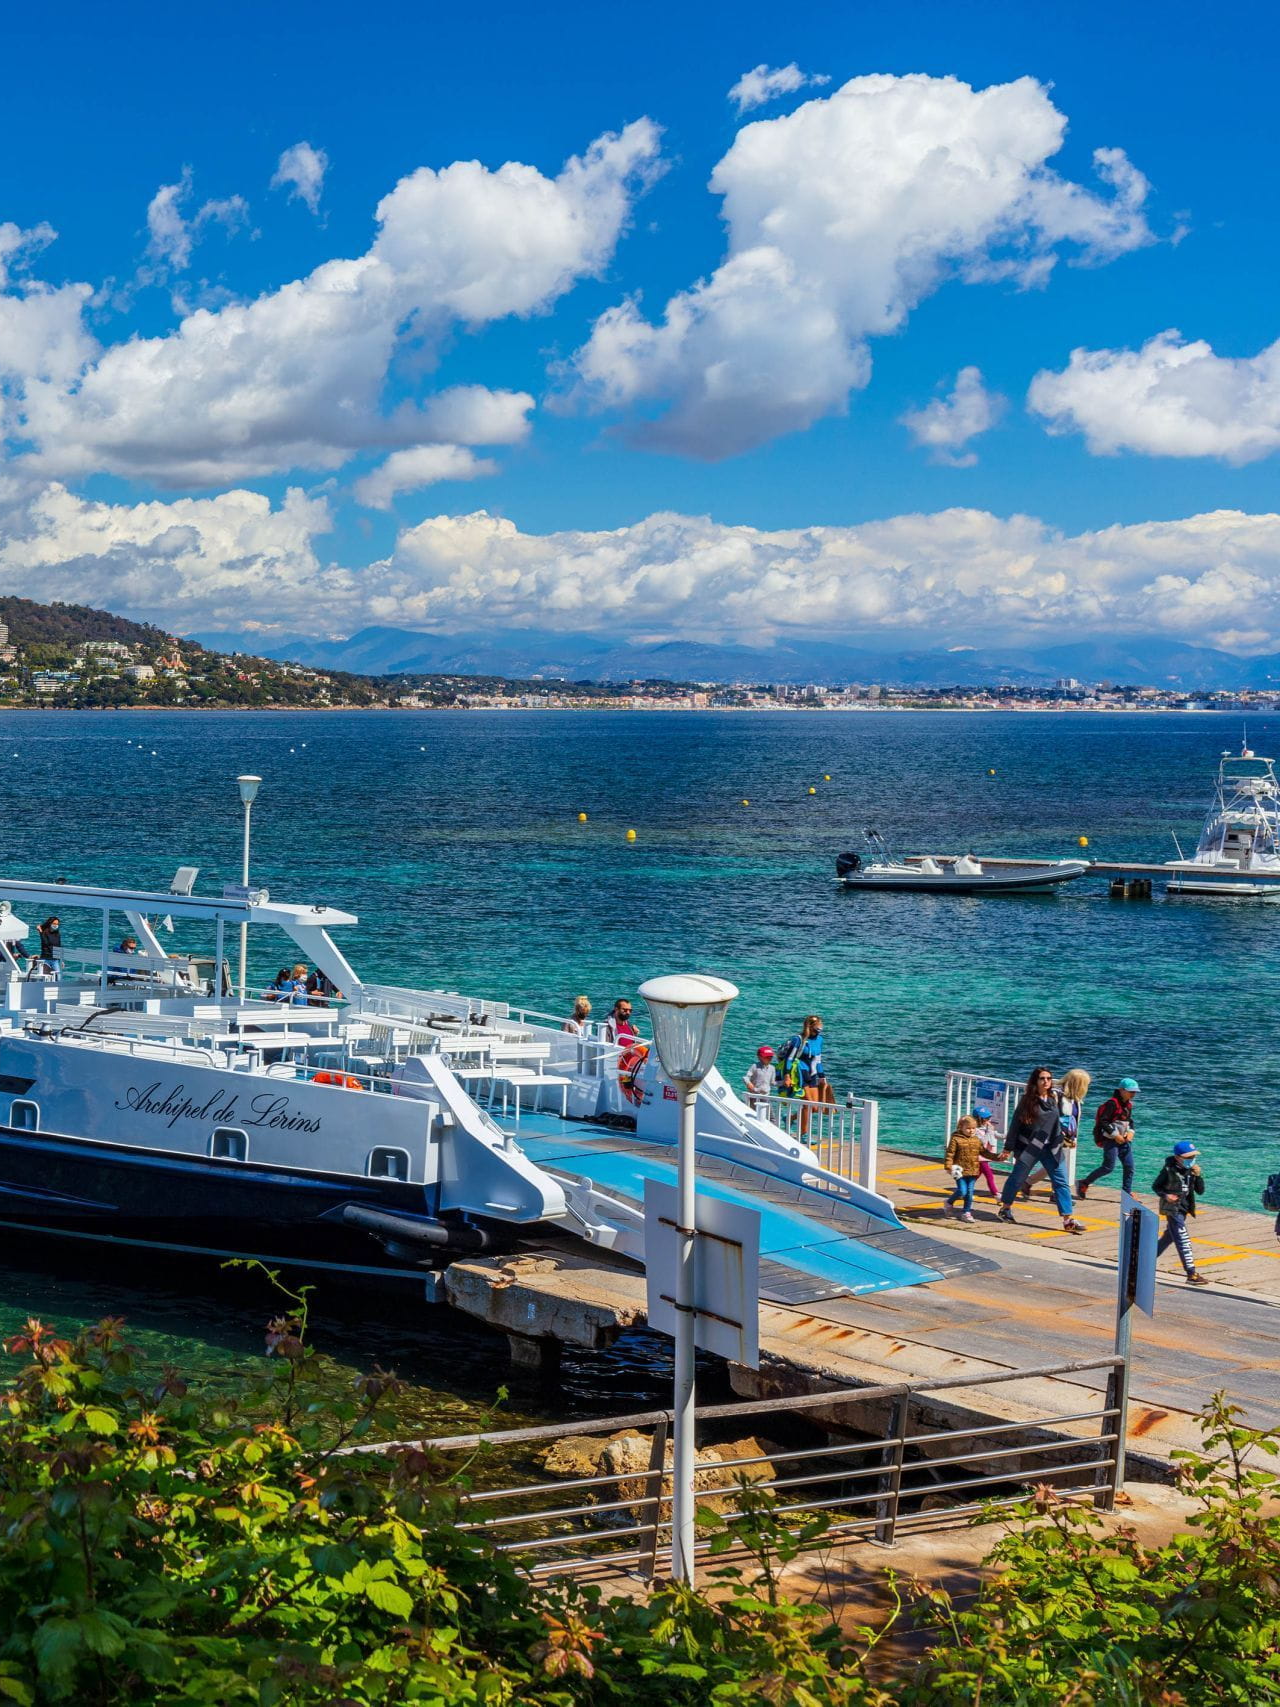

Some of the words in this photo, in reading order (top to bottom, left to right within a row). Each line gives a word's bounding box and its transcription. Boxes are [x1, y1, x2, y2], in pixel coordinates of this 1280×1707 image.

[114, 1082, 225, 1129] Archipel
[212, 1094, 239, 1122] de
[240, 1093, 323, 1133] Lérins
